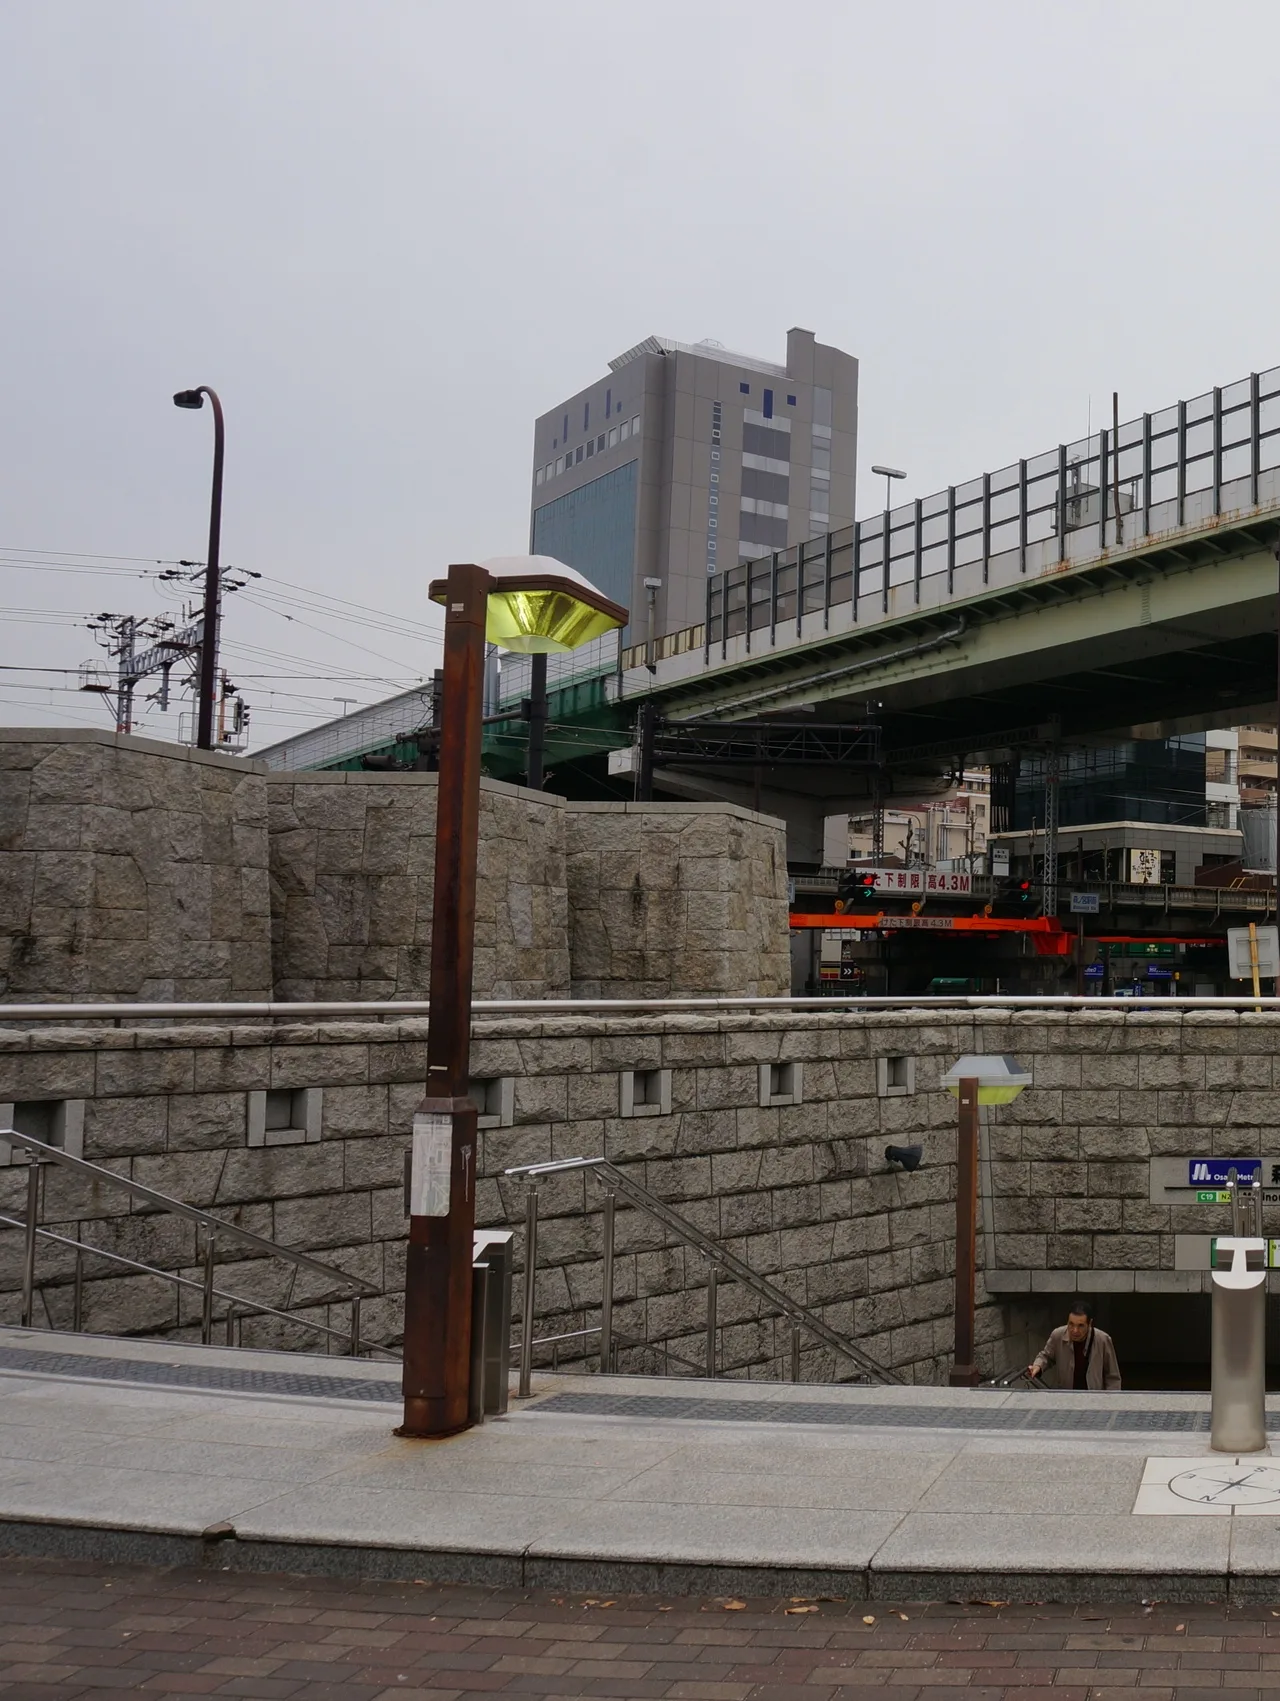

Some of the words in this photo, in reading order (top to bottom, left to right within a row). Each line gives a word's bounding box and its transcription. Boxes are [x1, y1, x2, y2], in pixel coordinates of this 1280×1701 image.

[863, 872, 970, 891] た下制限高4.3M
[1213, 1173, 1232, 1181] Osa
[1237, 1173, 1255, 1181] Metr
[1200, 1193, 1214, 1201] C19
